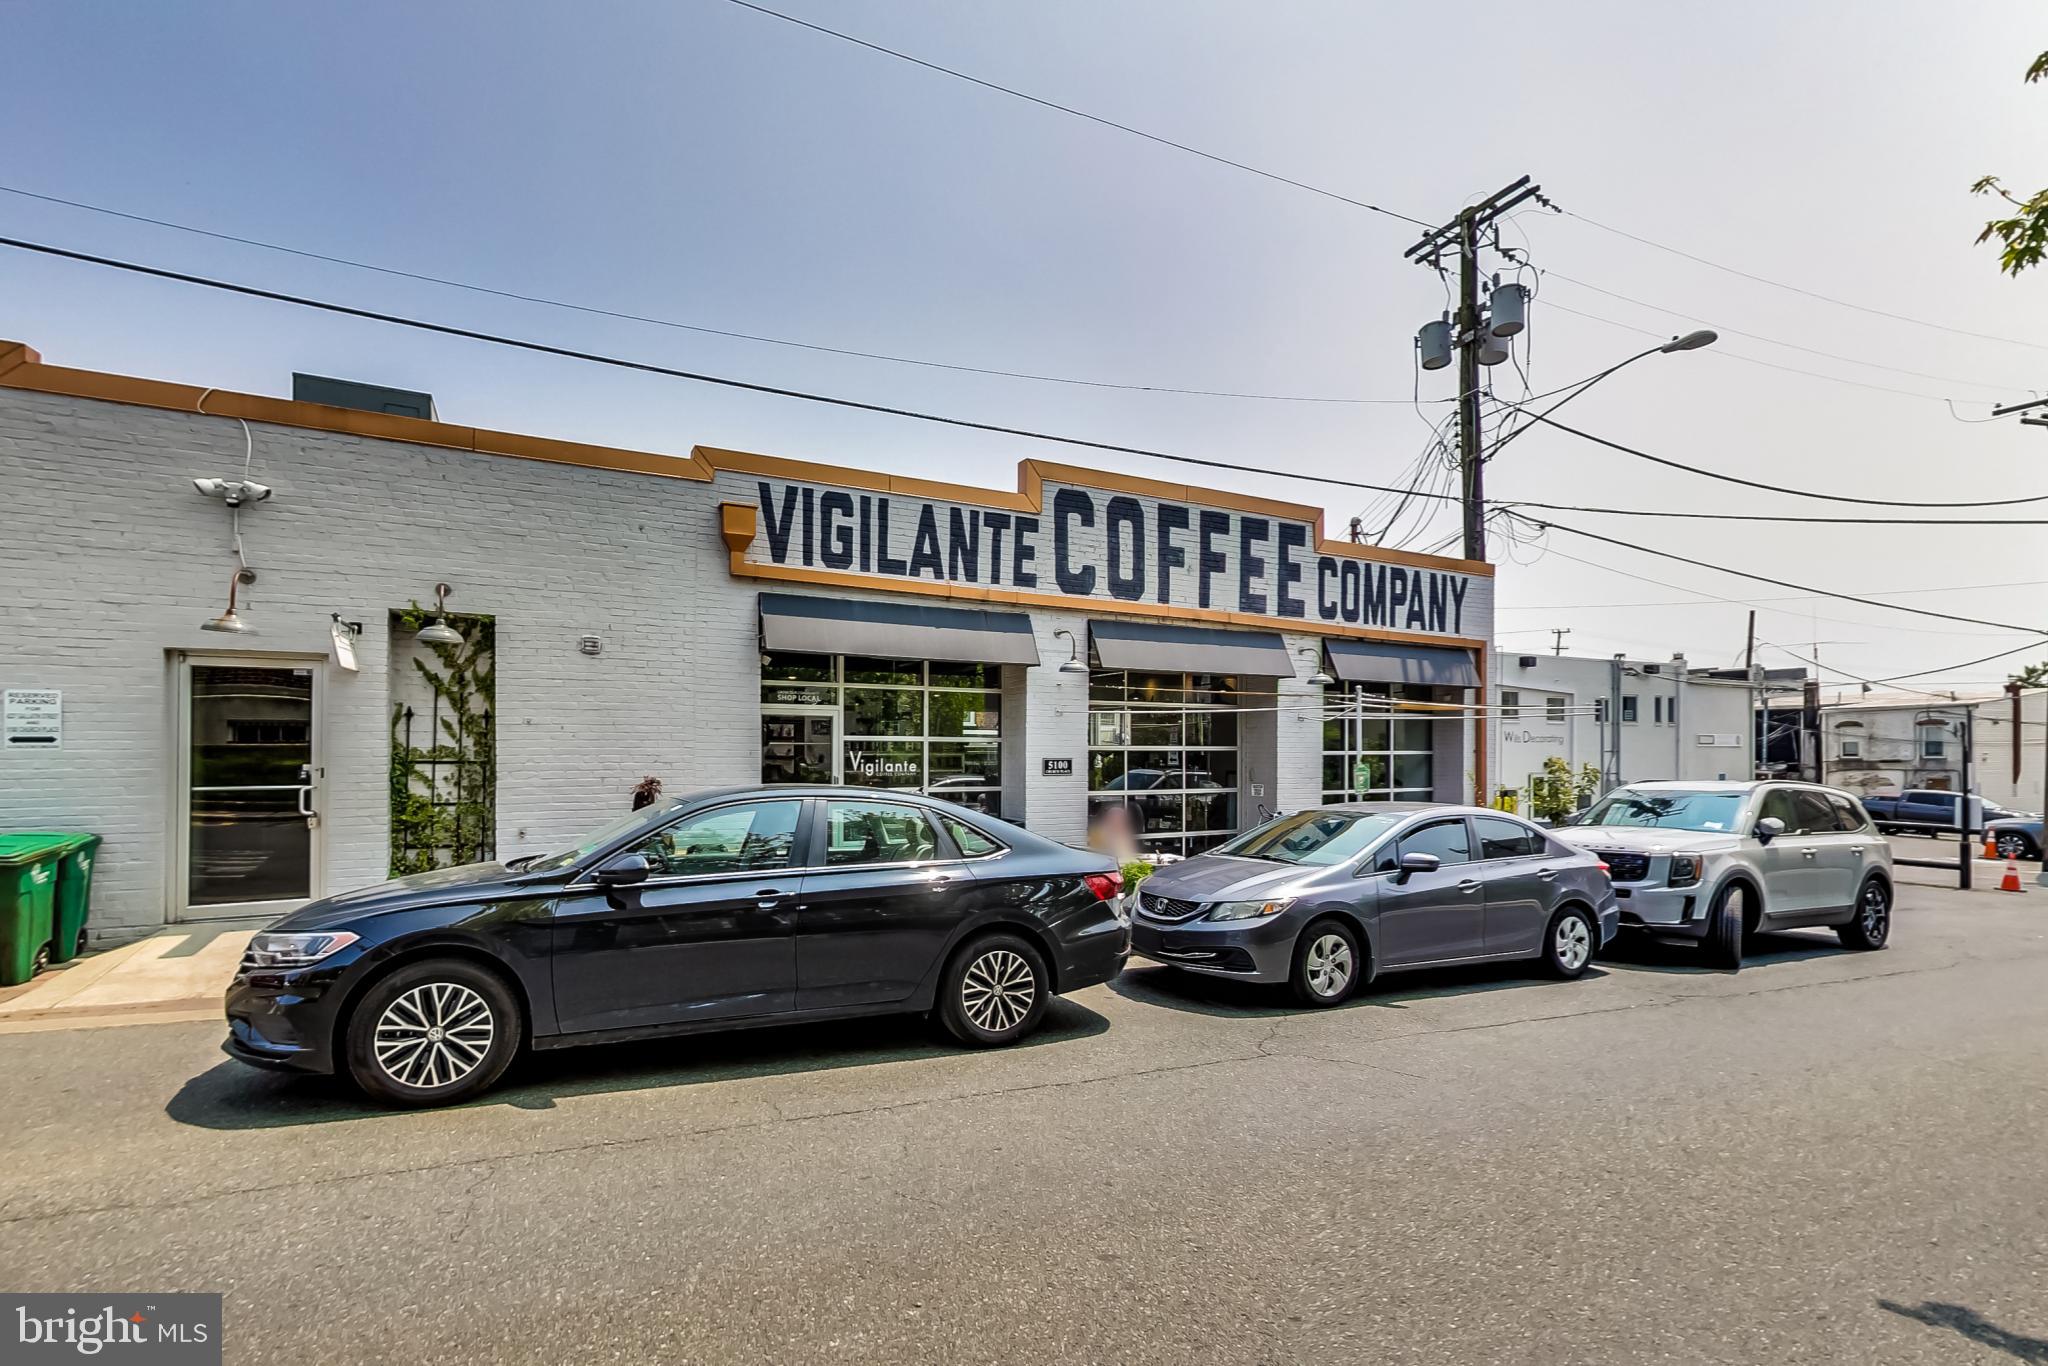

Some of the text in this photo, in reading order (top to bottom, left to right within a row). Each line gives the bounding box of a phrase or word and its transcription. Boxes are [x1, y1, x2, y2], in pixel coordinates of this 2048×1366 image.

[757, 481, 1468, 634] VIGILANTE COFFEE COMPANY
[798, 694, 821, 702] LOCAL
[1523, 730, 1565, 745] Decorating
[849, 750, 917, 776] Vigilante
[1048, 760, 1068, 769] 5100
